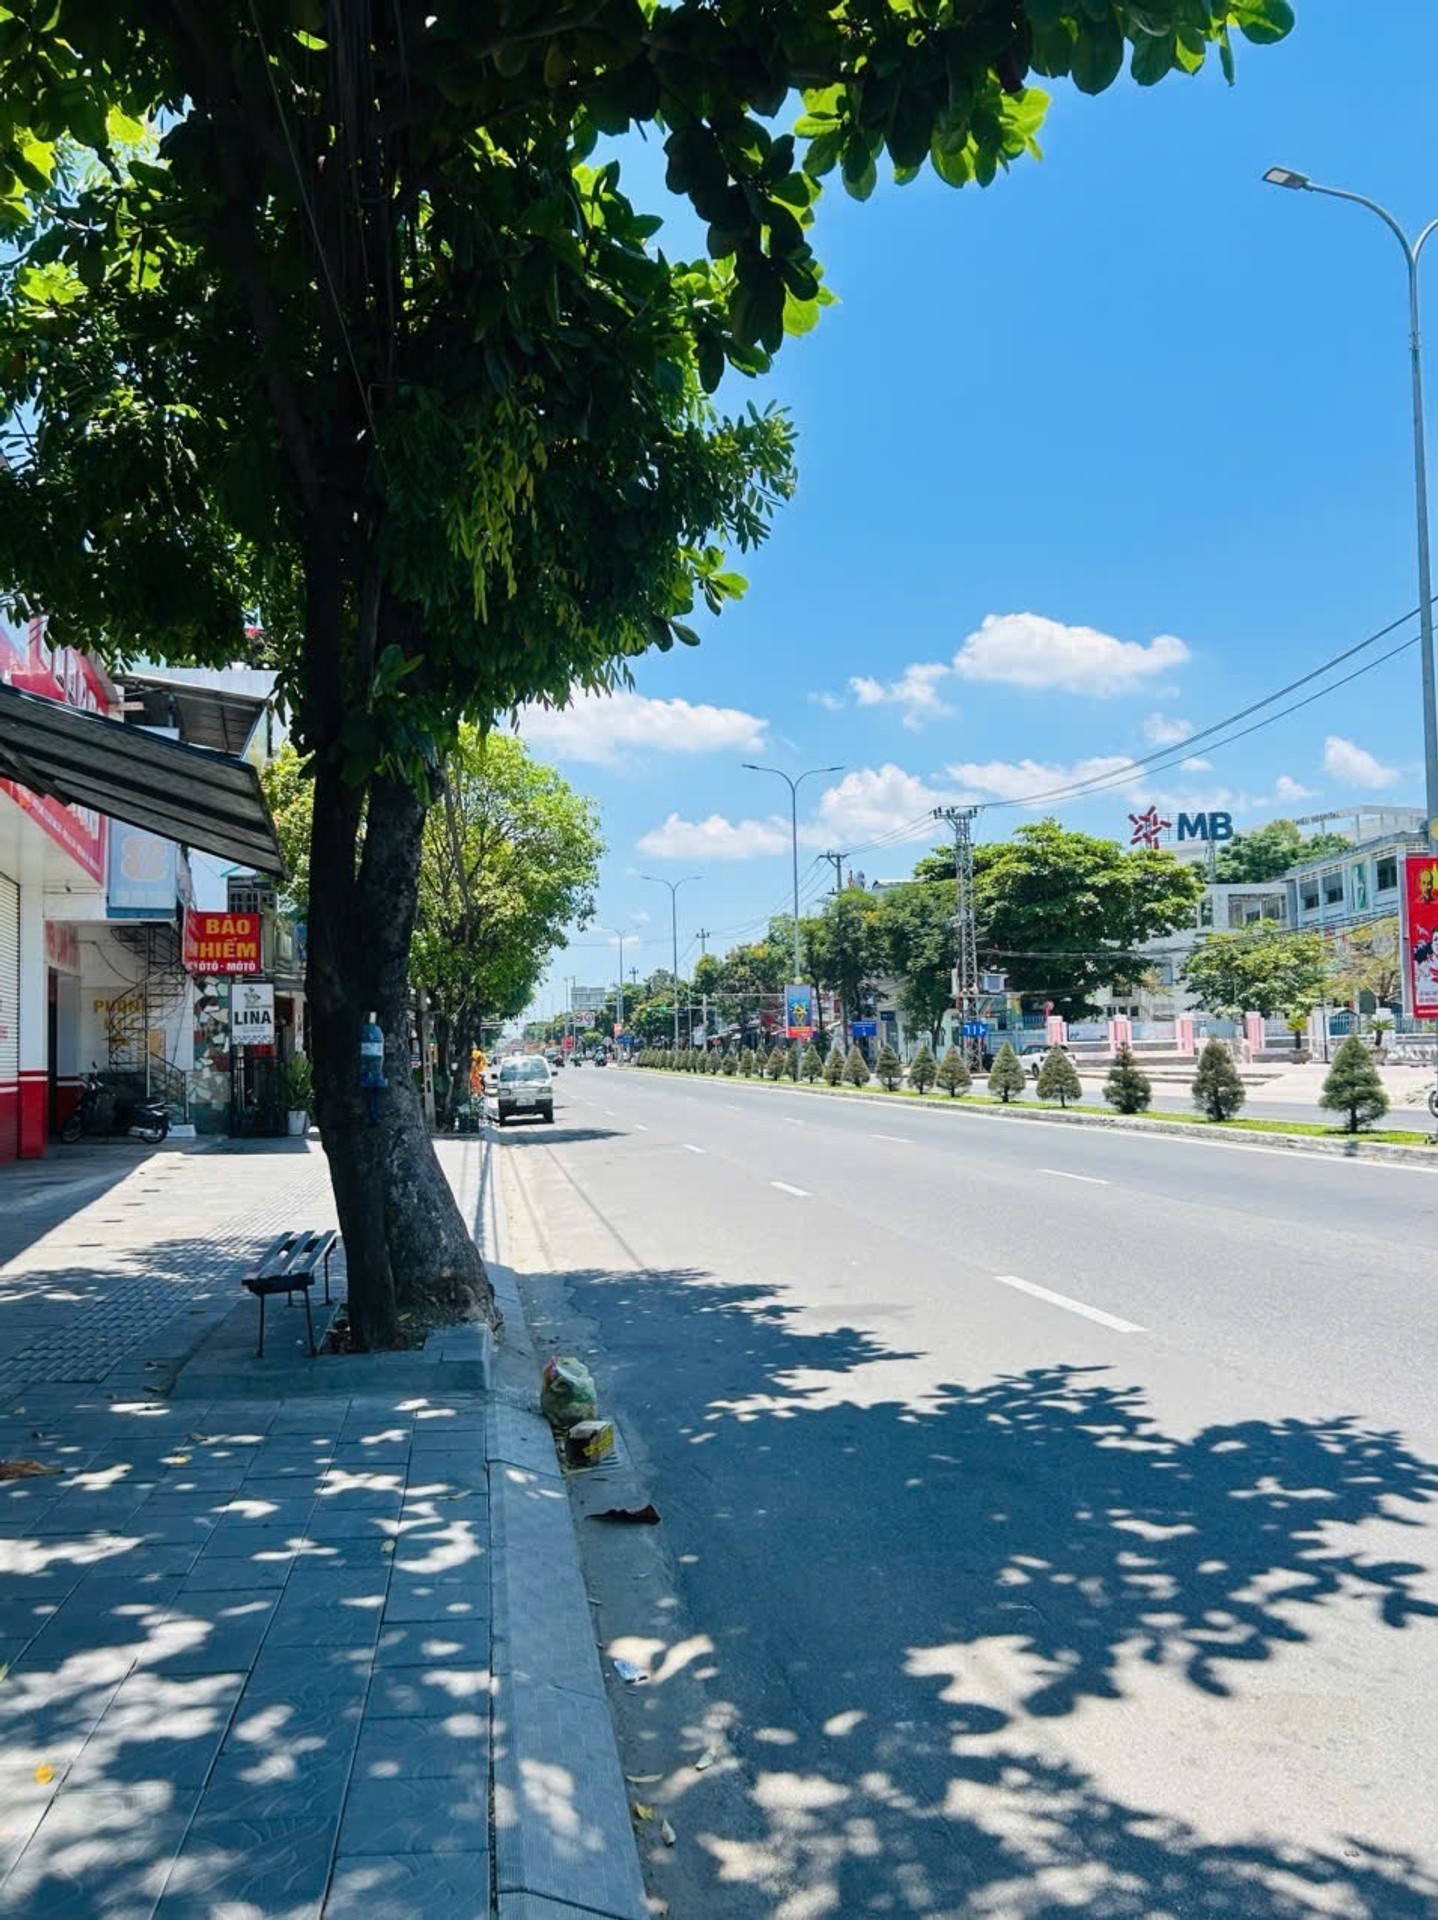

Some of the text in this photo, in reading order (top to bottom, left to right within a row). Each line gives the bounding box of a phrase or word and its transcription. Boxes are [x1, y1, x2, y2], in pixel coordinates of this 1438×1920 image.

[1178, 812, 1233, 841] MB
[206, 914, 251, 935] BẢO
[234, 1010, 272, 1025] LINA
